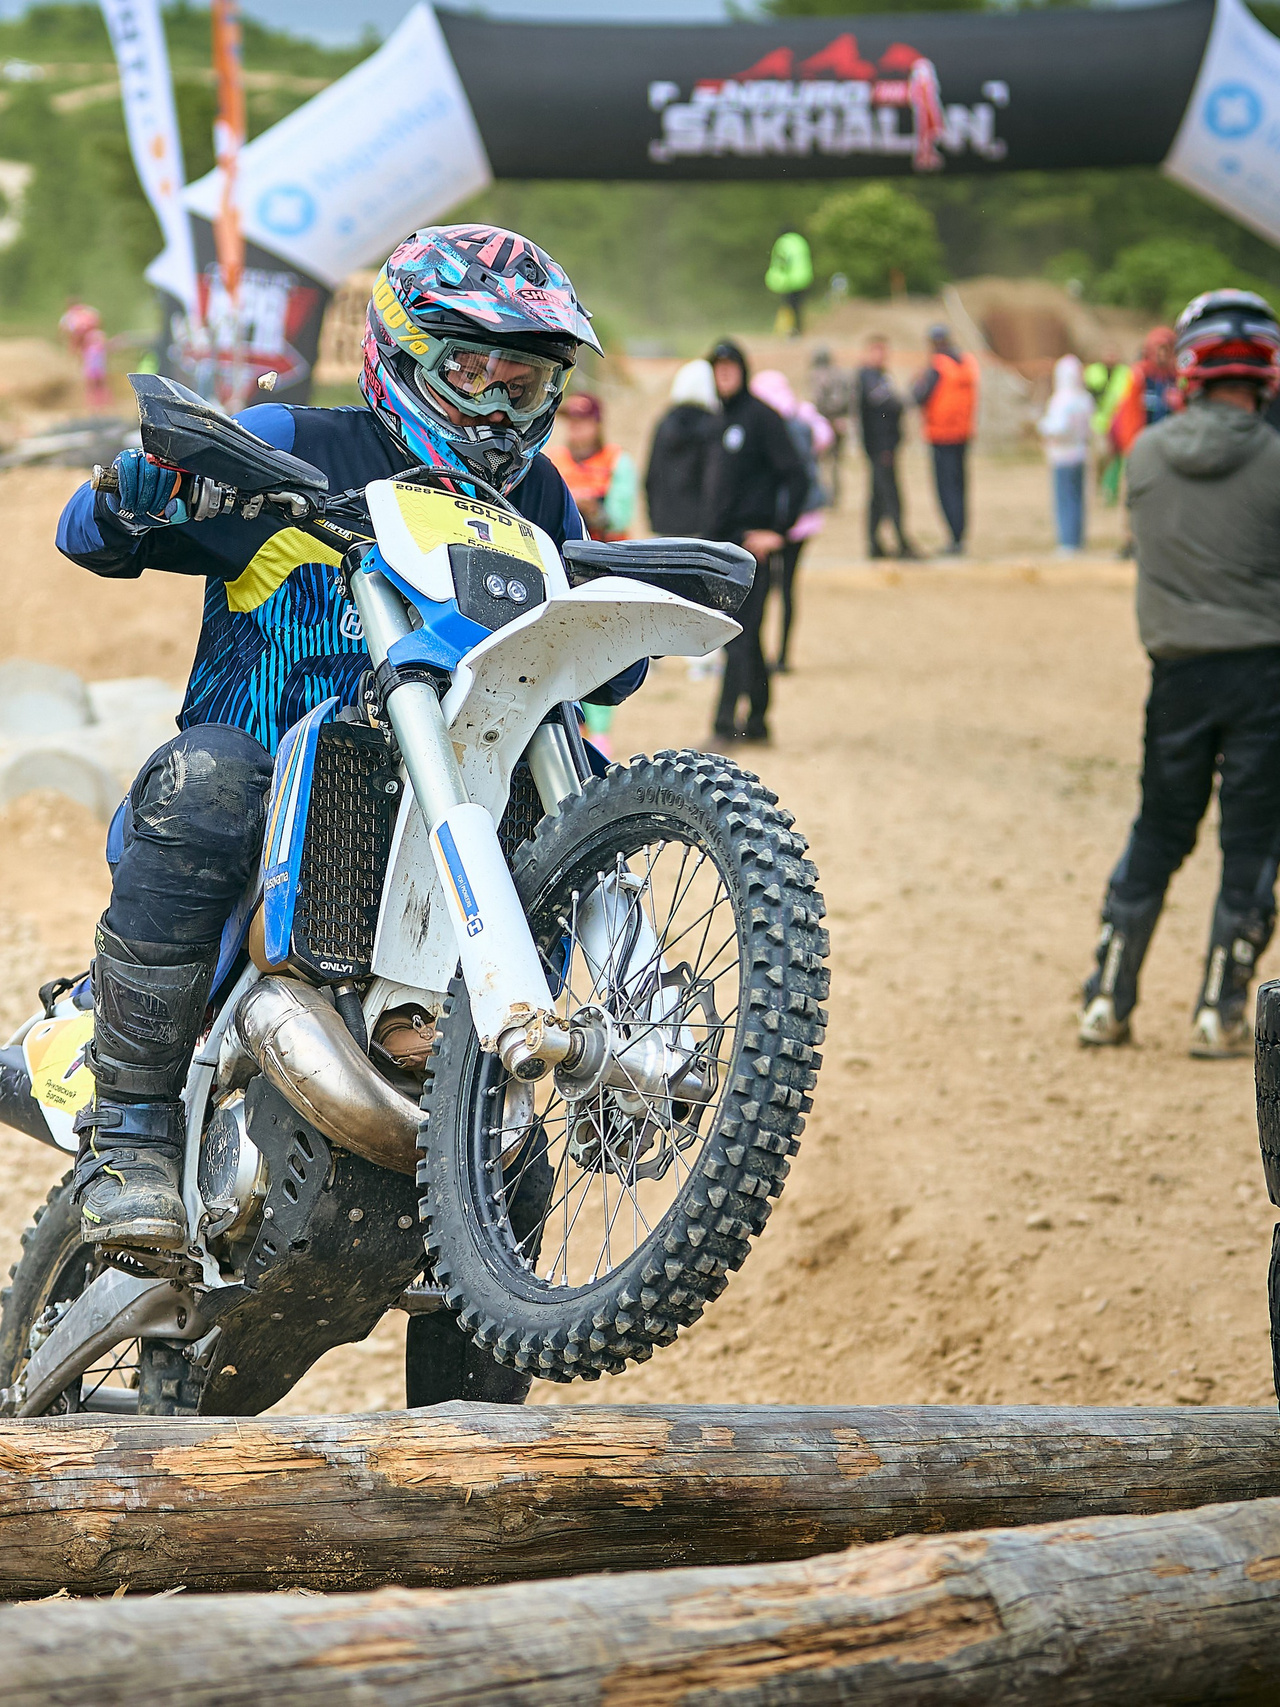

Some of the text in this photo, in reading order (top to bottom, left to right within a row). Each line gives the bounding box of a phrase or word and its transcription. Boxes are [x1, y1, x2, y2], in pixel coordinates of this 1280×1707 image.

[373, 273, 430, 355] 100%
[454, 500, 513, 527] GOLD
[466, 519, 492, 542] 1
